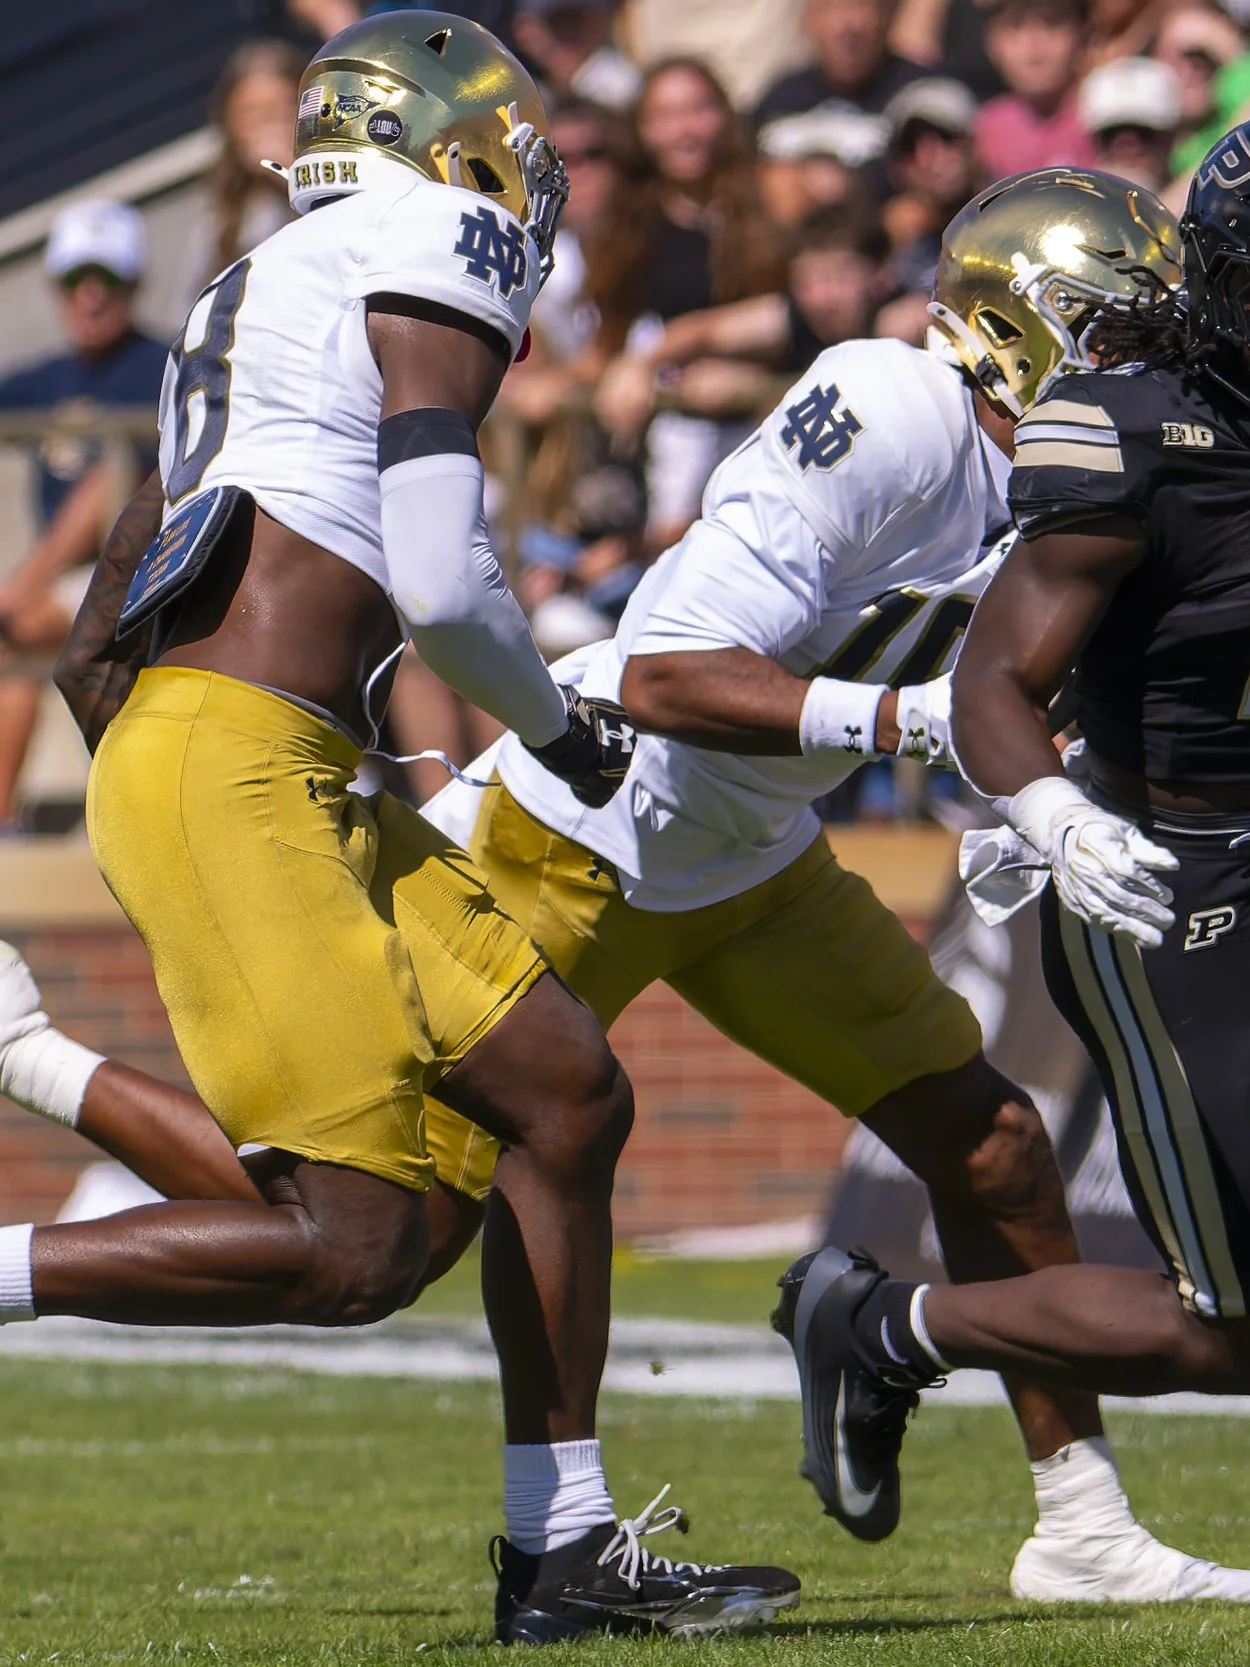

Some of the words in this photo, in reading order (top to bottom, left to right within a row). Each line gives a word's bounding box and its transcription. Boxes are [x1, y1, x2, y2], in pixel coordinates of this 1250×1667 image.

[295, 161, 359, 190] IRISH
[166, 256, 253, 509] 8
[1184, 906, 1236, 952] P
